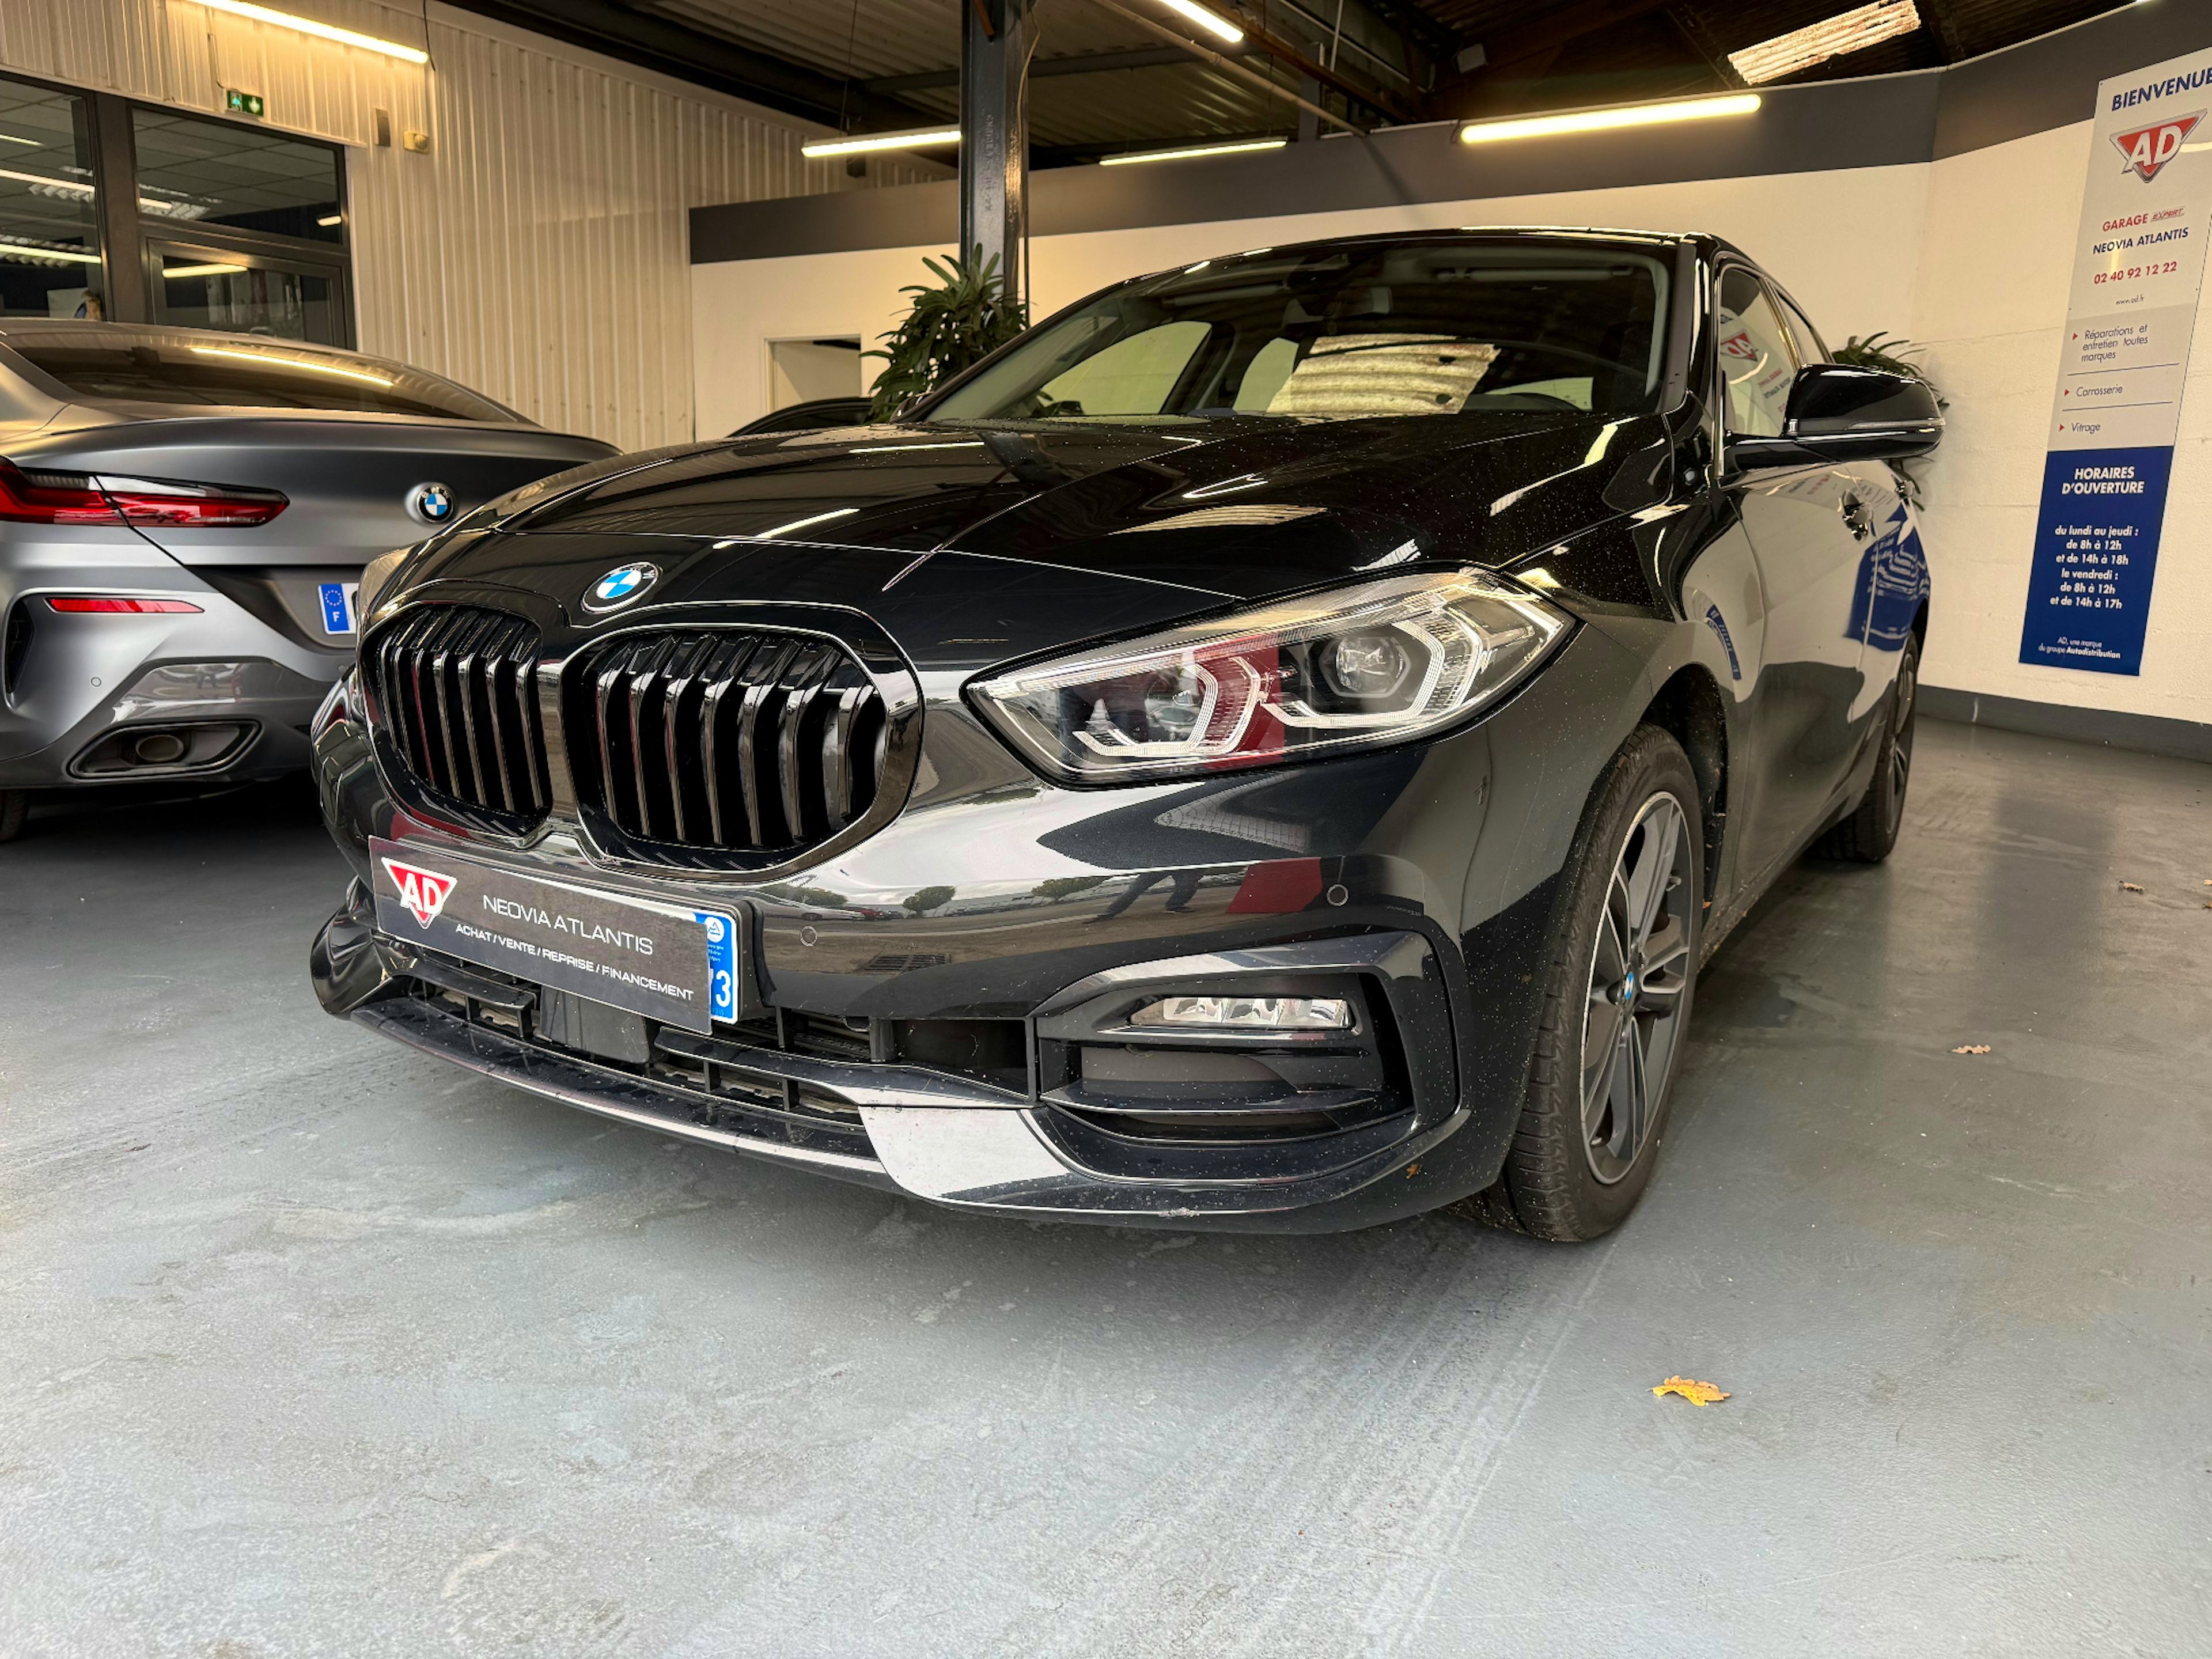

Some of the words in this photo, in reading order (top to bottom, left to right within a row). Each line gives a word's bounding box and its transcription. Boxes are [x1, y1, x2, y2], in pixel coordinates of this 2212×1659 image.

[2112, 67, 2212, 111] BIENVENUE
[2122, 125, 2183, 173] AD
[2103, 213, 2149, 232] GARAGE
[2093, 238, 2133, 255] NEOVIA
[2137, 227, 2189, 247] ATLANTIS
[2094, 273, 2107, 284] 02
[2110, 270, 2124, 281] 40
[2127, 267, 2141, 279] 92
[2146, 264, 2159, 276] 12
[2162, 261, 2177, 274] 22
[2085, 326, 2134, 342] Réparations
[2139, 324, 2147, 333] et
[2082, 339, 2118, 351] entretien
[2123, 336, 2148, 346] toutes
[2081, 351, 2116, 363] marques
[2076, 384, 2123, 396] Carrosserie
[2071, 423, 2101, 434] Vitrage
[2074, 466, 2135, 480] HORAIRES
[2061, 481, 2145, 495] D'OUVERTURE
[2055, 525, 2066, 535] du
[2069, 525, 2092, 536] lundi
[2094, 528, 2106, 536] au
[2108, 525, 2133, 539] jeudi
[2066, 539, 2078, 549] de
[2080, 539, 2092, 549] 8h
[2094, 540, 2101, 550] à
[2105, 540, 2122, 550] 12h
[2056, 554, 2065, 563] et
[2066, 552, 2078, 563] de
[2082, 554, 2099, 564] 14h
[2101, 554, 2108, 564] à
[2111, 554, 2129, 565] 18h
[2061, 567, 2070, 578] le
[2072, 569, 2113, 580] vendredi
[2060, 581, 2072, 592] de
[2074, 582, 2086, 593] 8h
[2088, 583, 2094, 593] à
[2098, 584, 2116, 594] 12h
[2050, 596, 2059, 605] et
[2061, 595, 2073, 605] de
[2075, 596, 2092, 607] 14h
[2094, 597, 2101, 608] à
[2105, 598, 2123, 609] 17h
[332, 611, 340, 622] F
[2038, 643, 2046, 652] du
[2046, 645, 2065, 654] groupe
[2066, 646, 2121, 659] Autodistribution
[2081, 640, 2102, 649] marque
[483, 895, 551, 928] NEOVIA
[554, 915, 653, 956] ATLANTIS
[456, 923, 493, 943] ACHAT
[497, 934, 536, 955] VENTE
[542, 948, 594, 972] REPRISE
[601, 965, 695, 1001] FINANCEMENT
[710, 968, 731, 1007] 3
